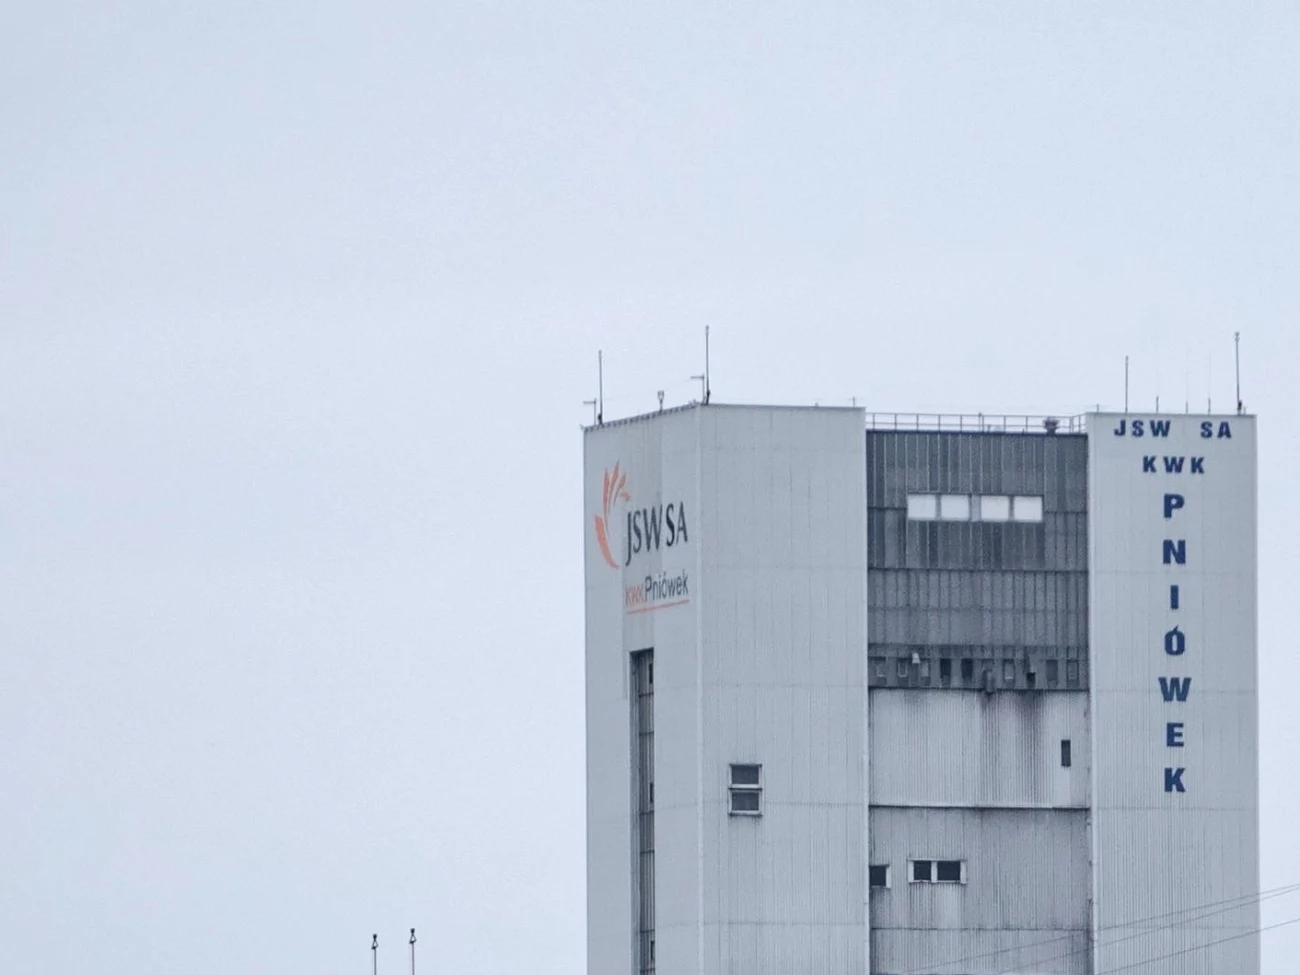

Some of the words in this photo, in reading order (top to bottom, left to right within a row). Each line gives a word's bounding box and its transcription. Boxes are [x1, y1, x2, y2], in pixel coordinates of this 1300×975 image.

[1114, 420, 1170, 437] JSW
[1200, 421, 1232, 439] SA
[1143, 456, 1205, 474] KWK
[645, 569, 689, 602] Pniówek
[1159, 493, 1191, 792] PNIÓWEK
